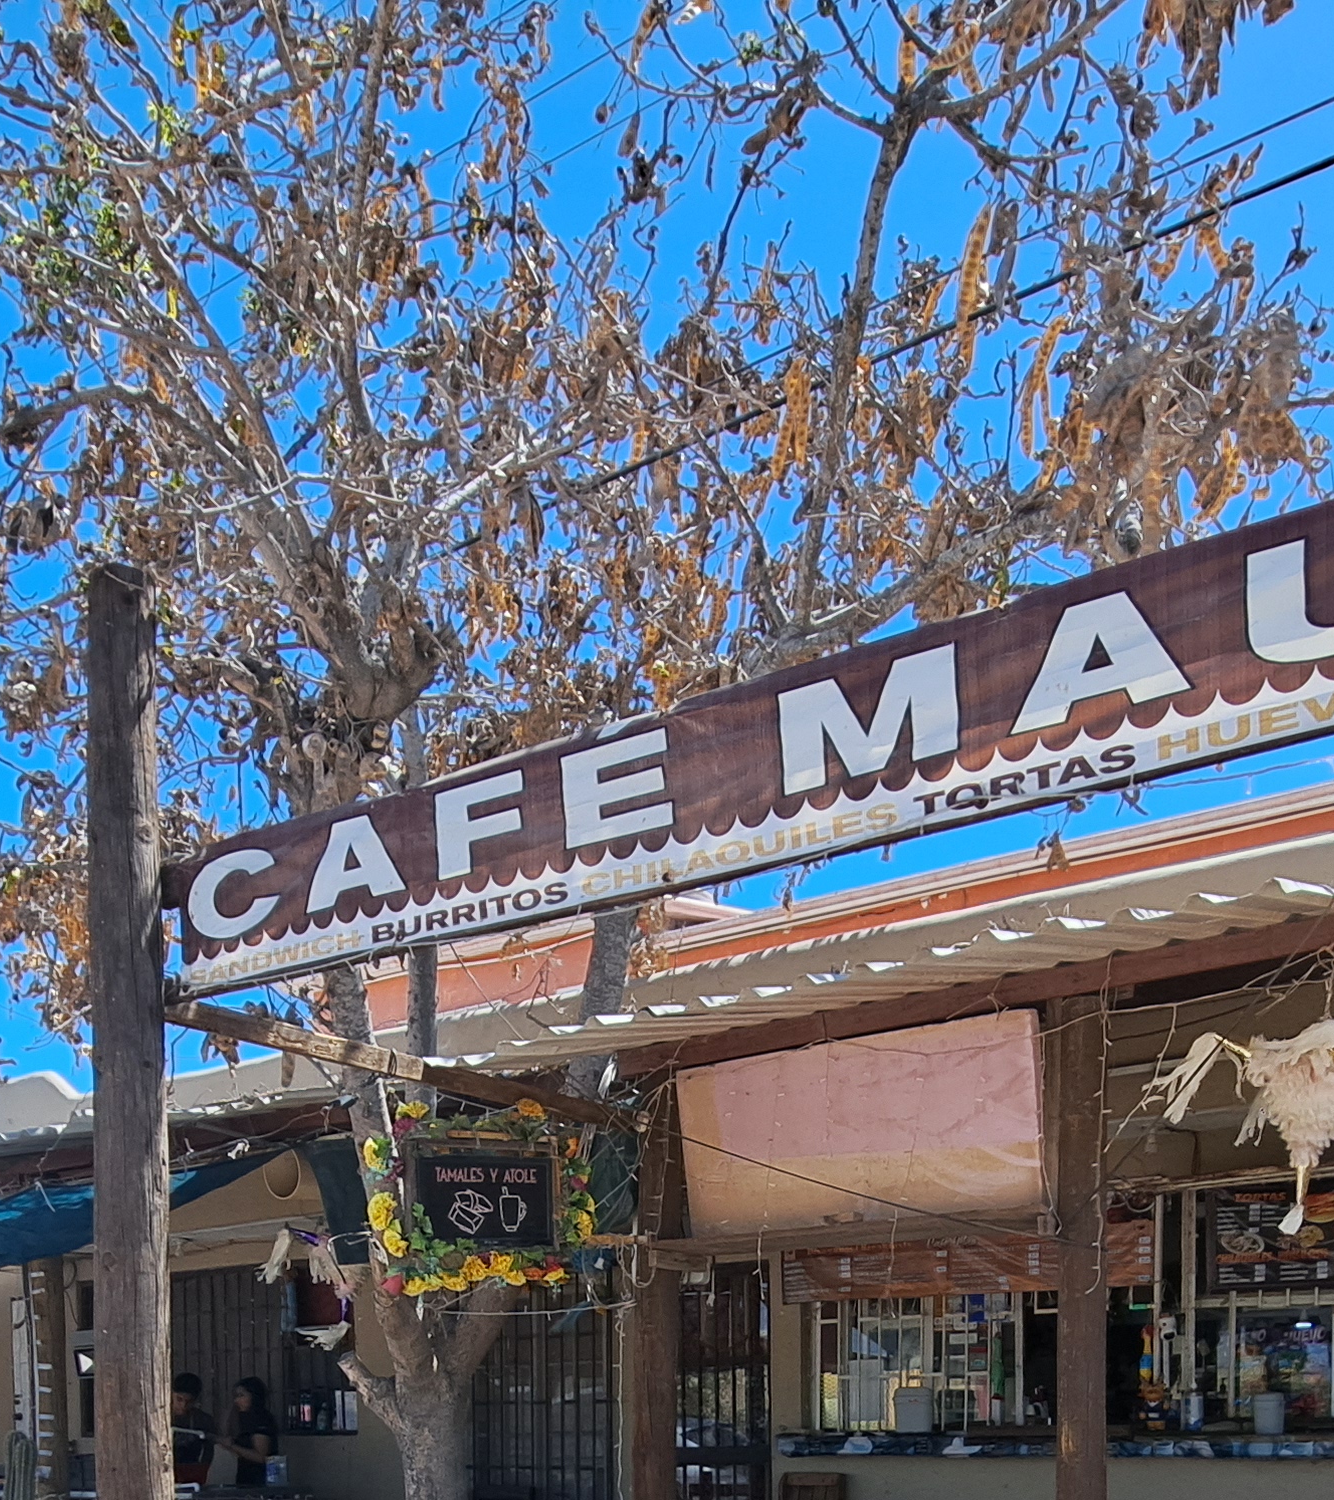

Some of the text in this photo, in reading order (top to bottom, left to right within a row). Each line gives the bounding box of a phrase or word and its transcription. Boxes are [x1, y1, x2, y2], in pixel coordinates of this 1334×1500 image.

[189, 929, 365, 984] SANDWICH
[370, 881, 568, 943] BURRITOS
[581, 802, 898, 898] CHILAQUILES
[913, 745, 1137, 816] TORTAS
[435, 1166, 537, 1183] TAMALES Y ATOLE
